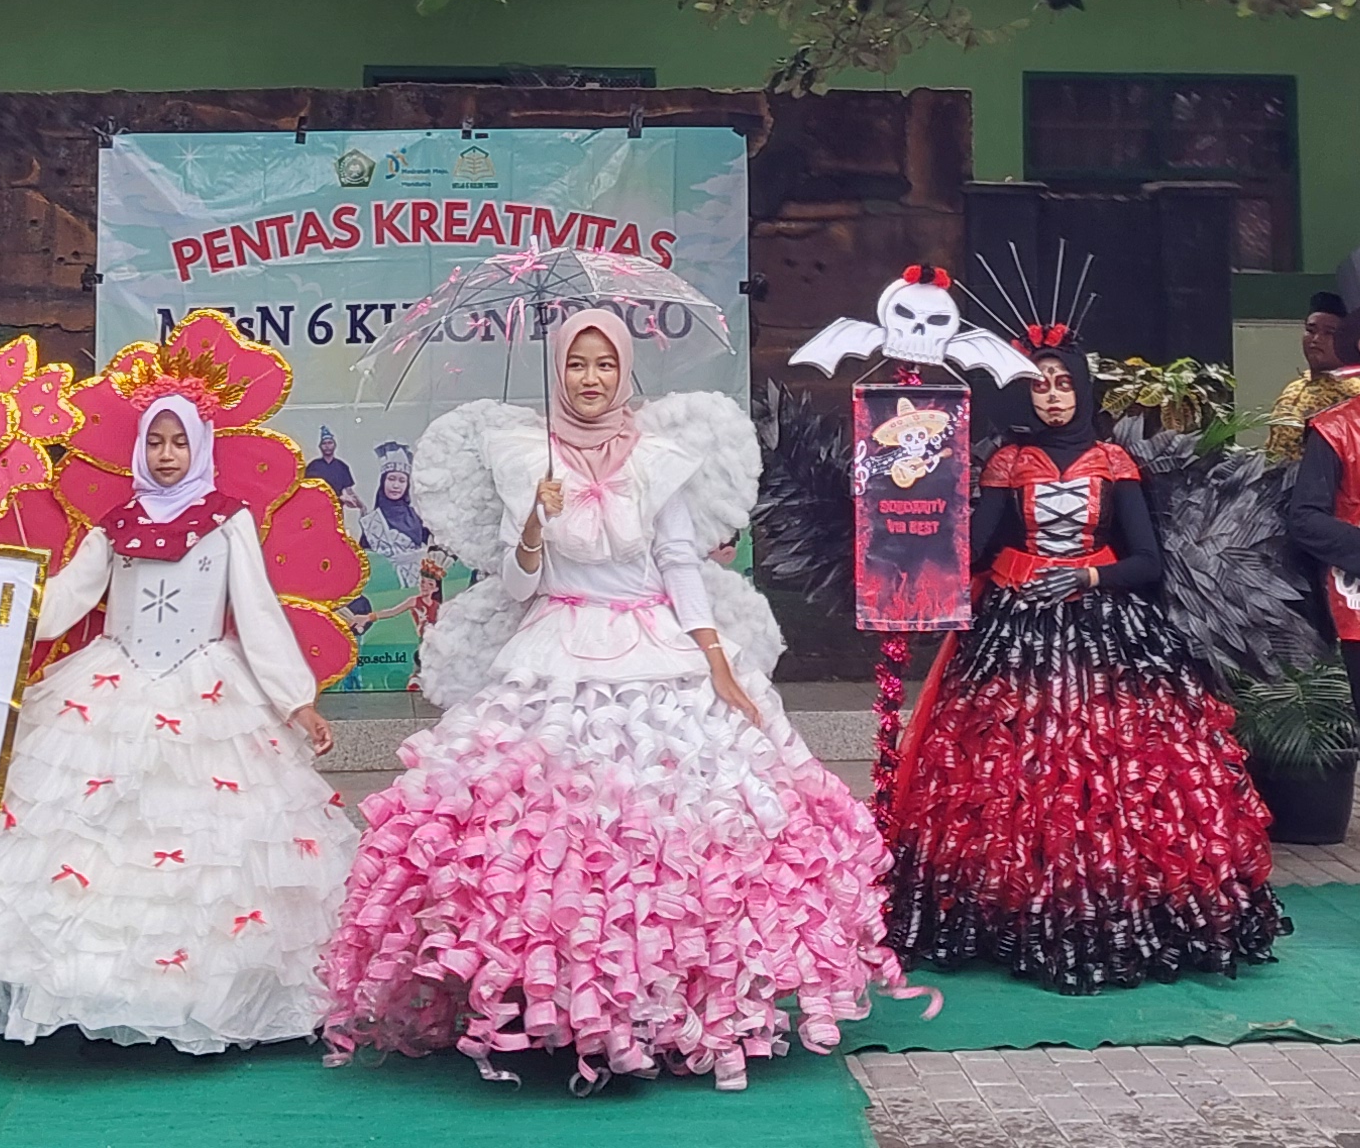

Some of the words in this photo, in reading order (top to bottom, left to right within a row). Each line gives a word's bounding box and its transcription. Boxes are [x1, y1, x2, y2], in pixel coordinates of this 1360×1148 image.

[171, 206, 361, 282] PENTAS
[374, 202, 677, 270] KREATIVITAS
[307, 302, 334, 345] 6
